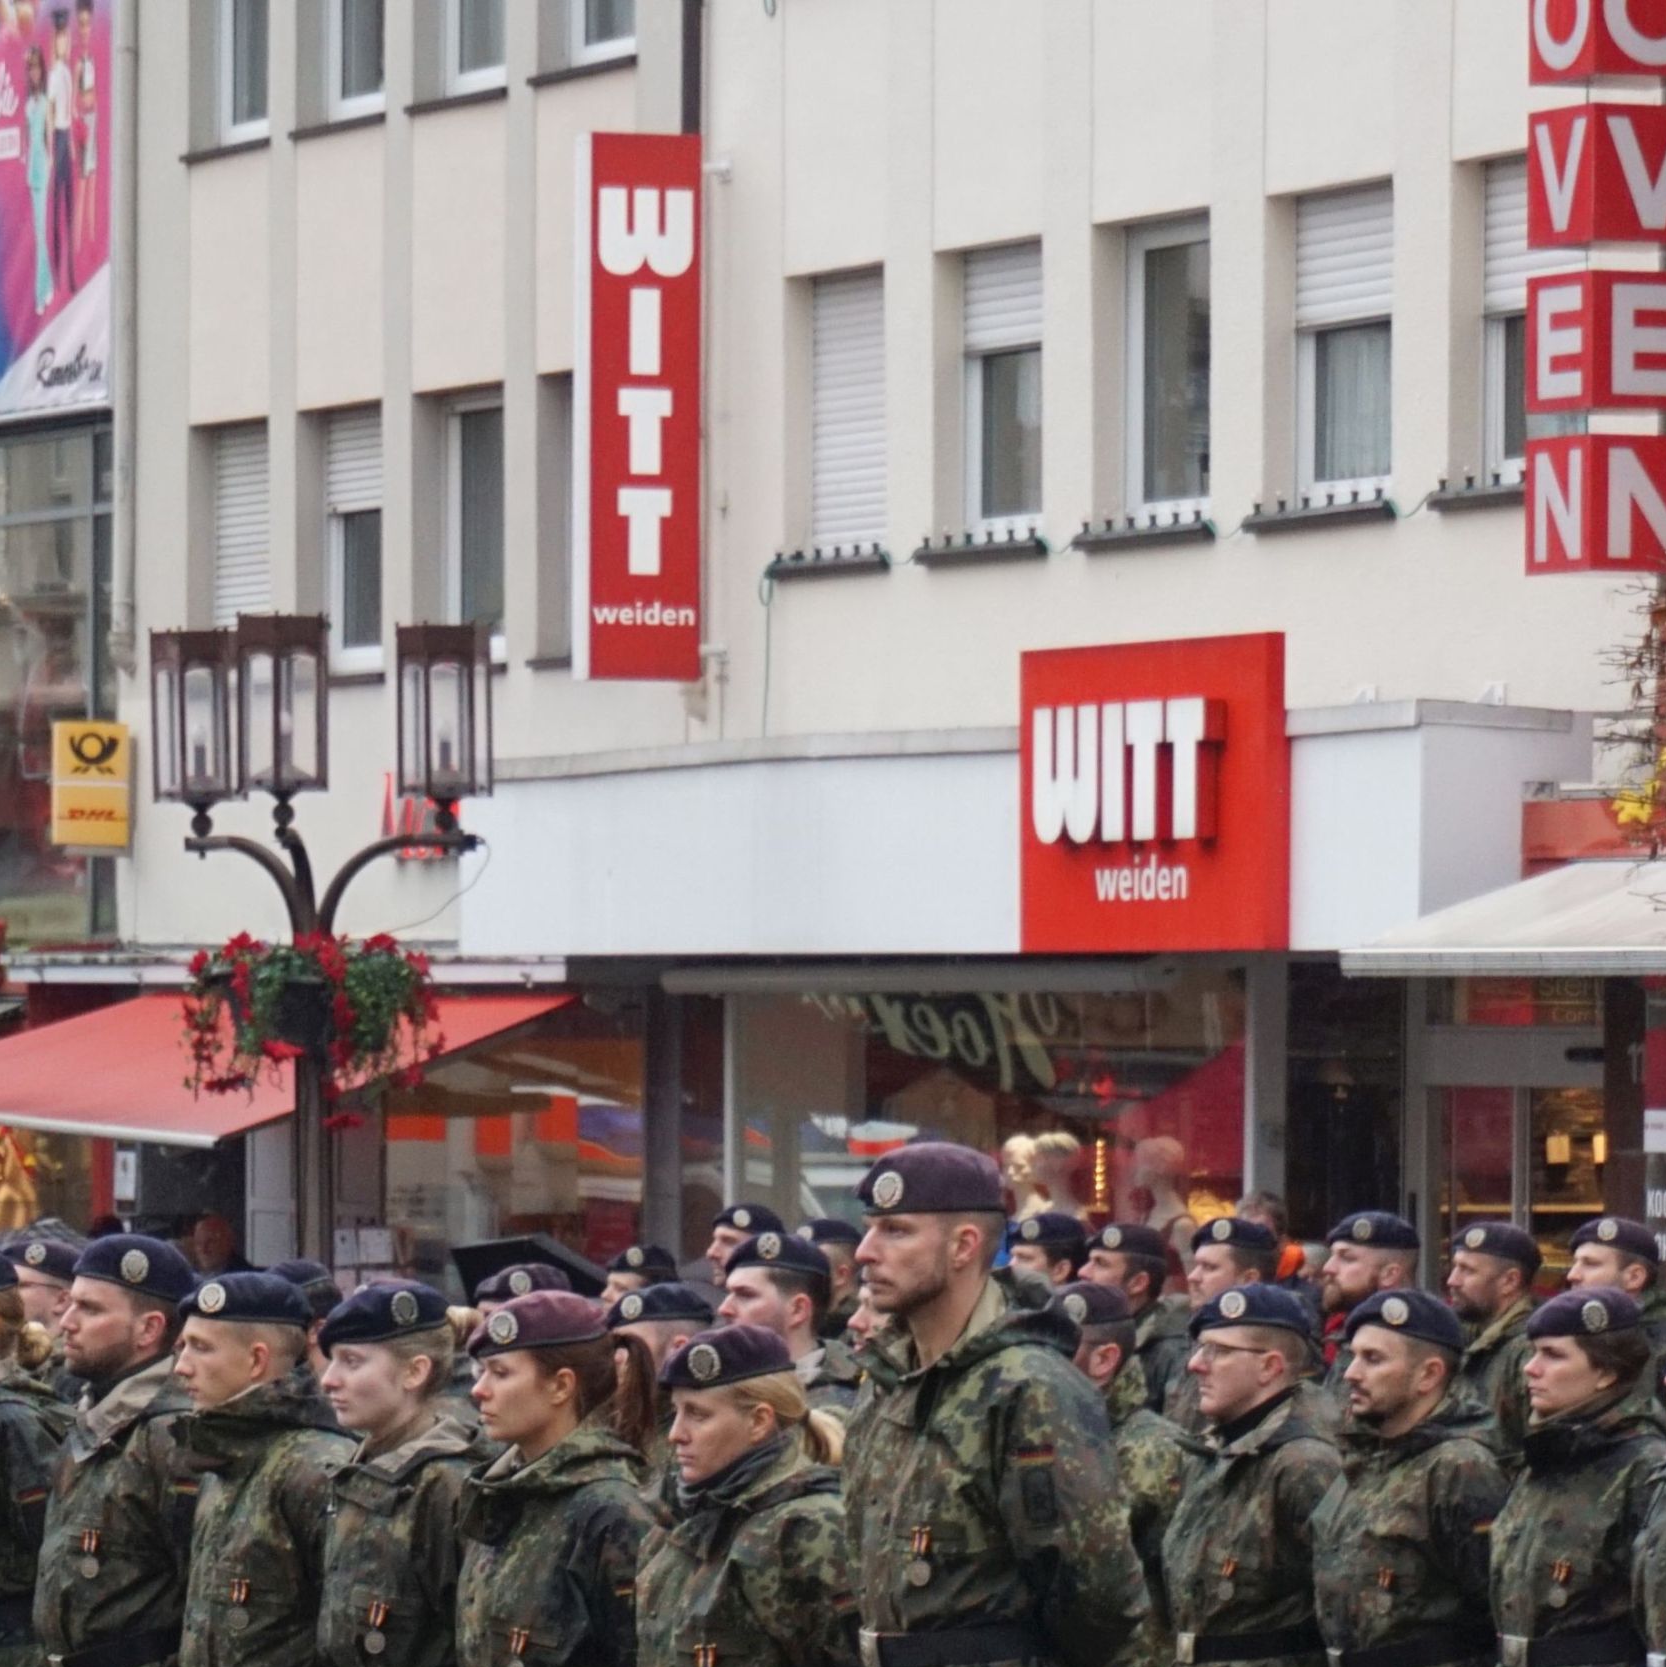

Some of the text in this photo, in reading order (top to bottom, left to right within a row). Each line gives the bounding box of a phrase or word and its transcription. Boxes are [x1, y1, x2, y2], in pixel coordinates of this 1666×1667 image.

[599, 186, 694, 576] WITT
[592, 601, 696, 627] weiden
[1033, 697, 1205, 844] WITT
[1094, 854, 1187, 901] weiden
